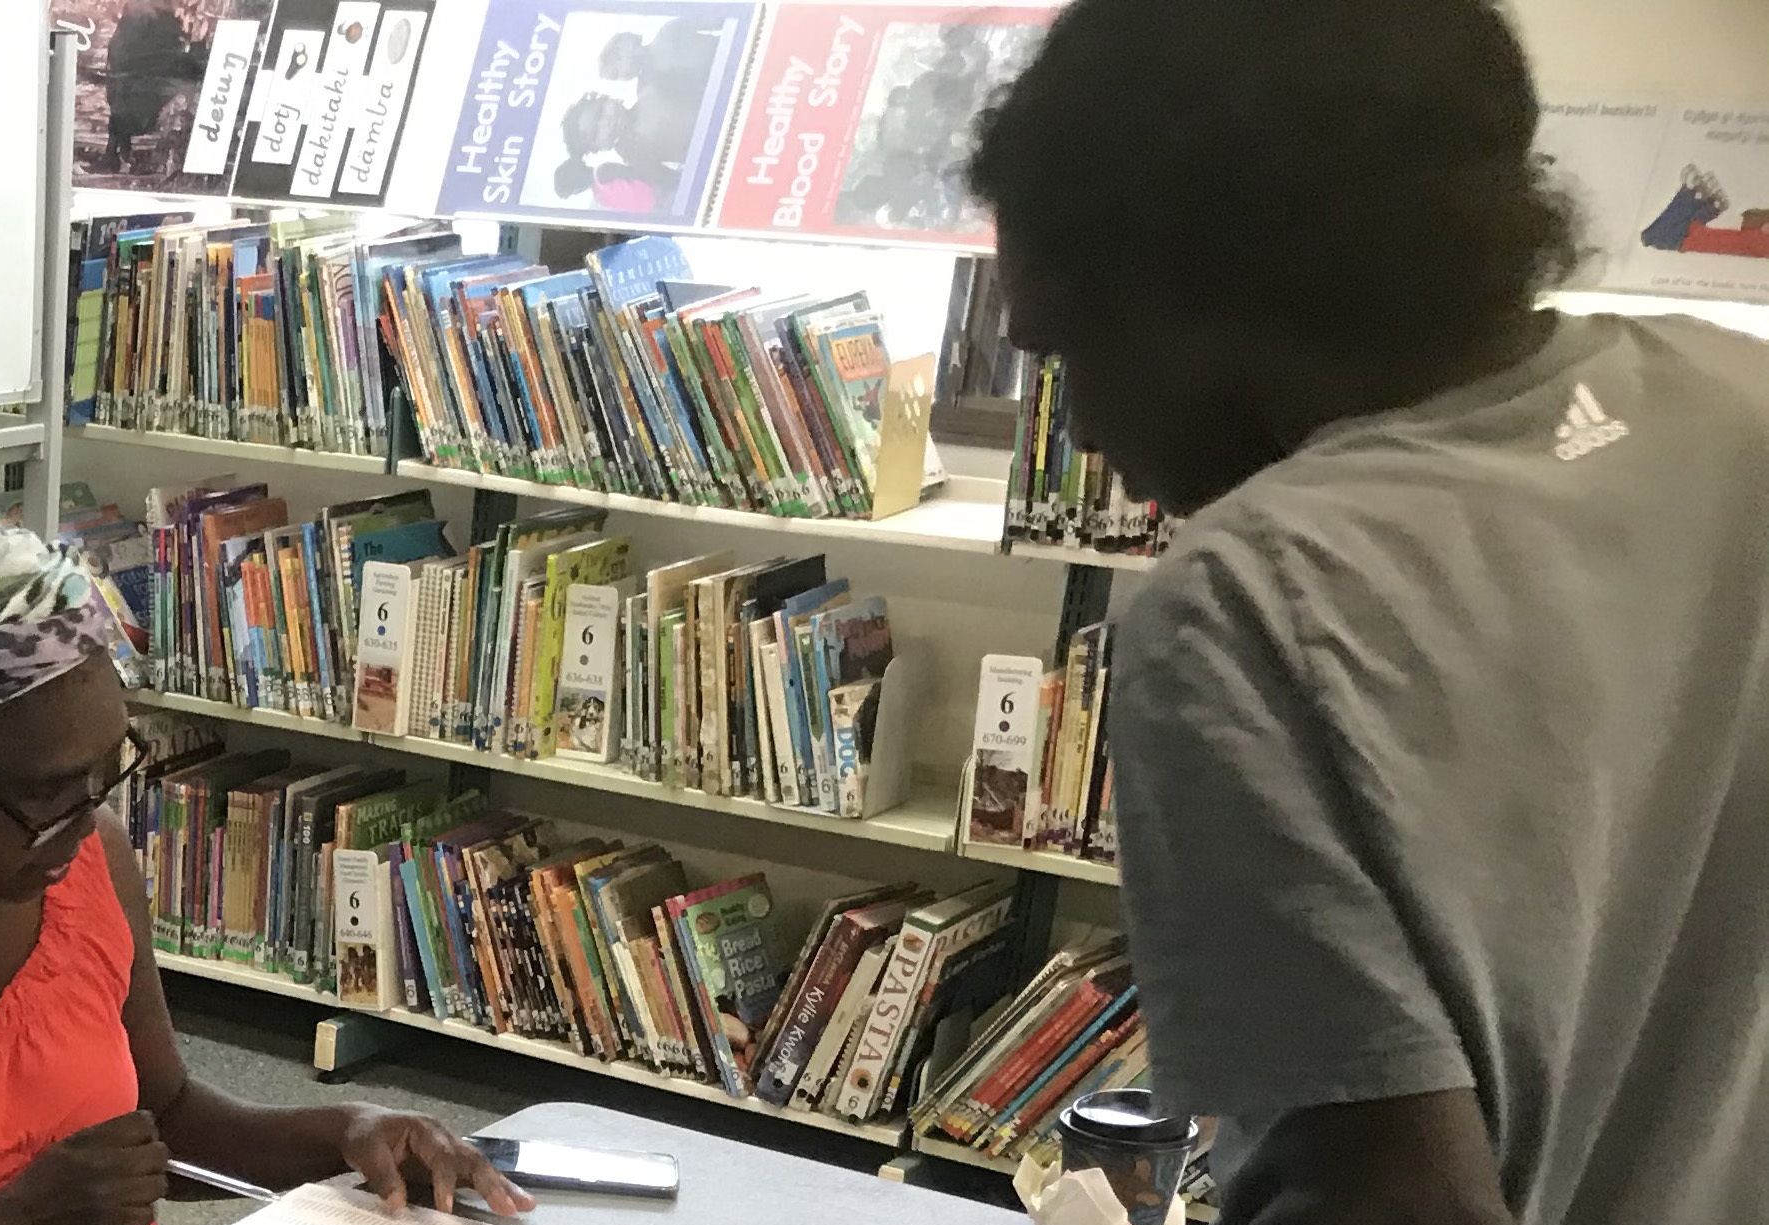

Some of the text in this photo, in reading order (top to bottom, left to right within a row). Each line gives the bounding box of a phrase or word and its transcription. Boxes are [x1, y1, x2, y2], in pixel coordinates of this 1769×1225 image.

[456, 39, 520, 174] Healthy
[483, 13, 562, 204] Skin Story
[301, 68, 349, 186] dakitaki
[746, 55, 815, 185] Healthy
[772, 132, 824, 228] Blood
[809, 14, 865, 108] Story
[350, 81, 394, 184] dämba
[377, 602, 389, 622] 6
[363, 637, 398, 651] 630-635
[581, 624, 594, 645] 6
[565, 671, 603, 686] 636-638
[1000, 691, 1015, 715] 6
[982, 732, 1027, 746] 670-699
[821, 778, 831, 794] 6
[356, 799, 398, 825] MAKING
[349, 890, 360, 910] 6
[340, 928, 373, 940] 640-646
[721, 927, 762, 958] Bread
[297, 956, 305, 967] 6
[727, 955, 765, 979] Rice
[797, 986, 825, 1025] Kylie
[856, 954, 919, 1063] PASTA
